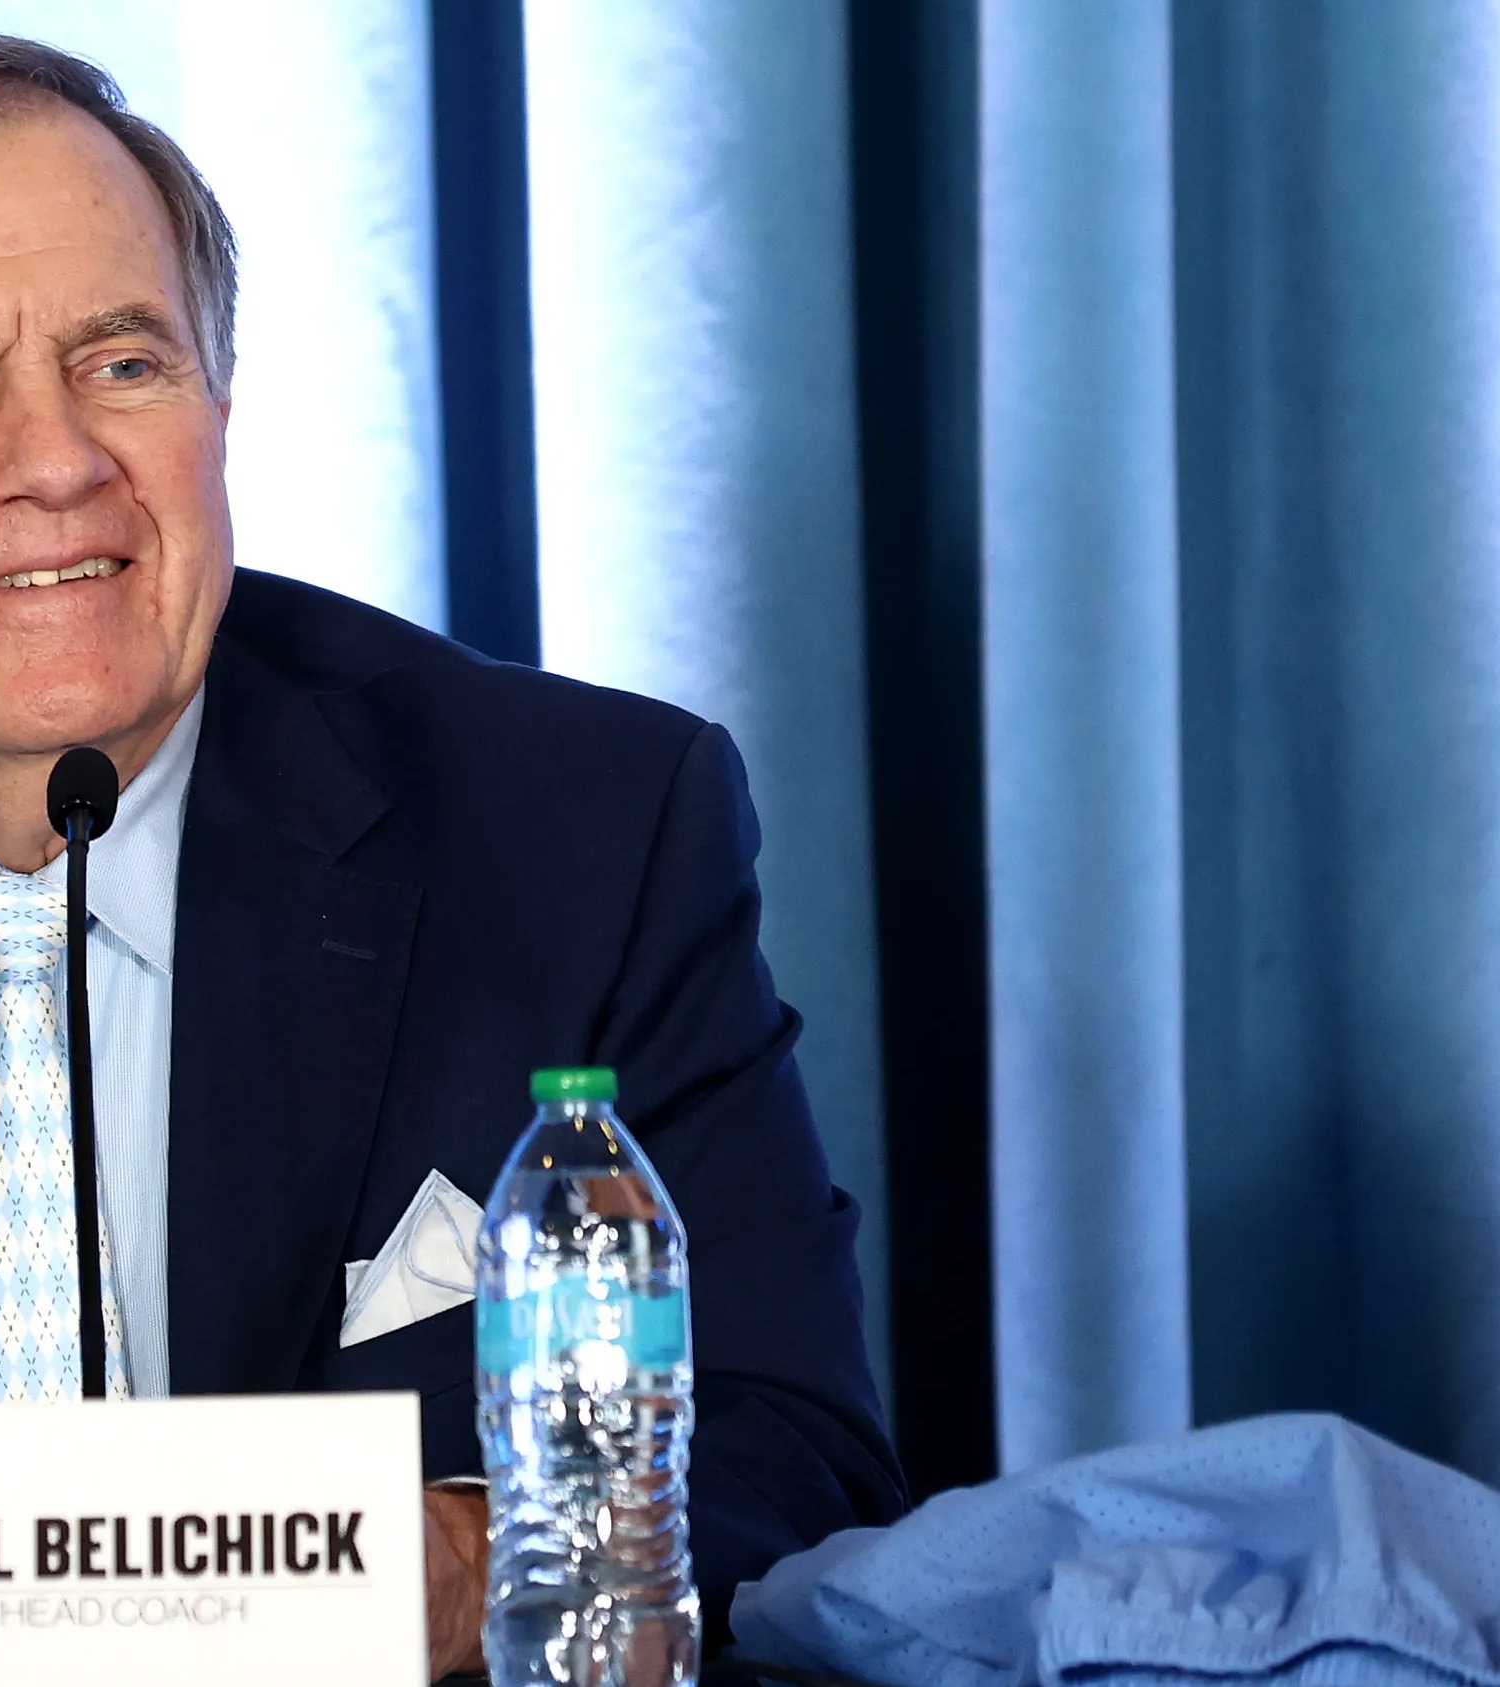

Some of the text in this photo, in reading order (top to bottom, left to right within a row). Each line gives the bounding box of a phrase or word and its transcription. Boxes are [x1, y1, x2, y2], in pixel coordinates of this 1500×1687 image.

[35, 1511, 366, 1579] BELICHICK
[0, 1596, 248, 1628] HEAD COACH
